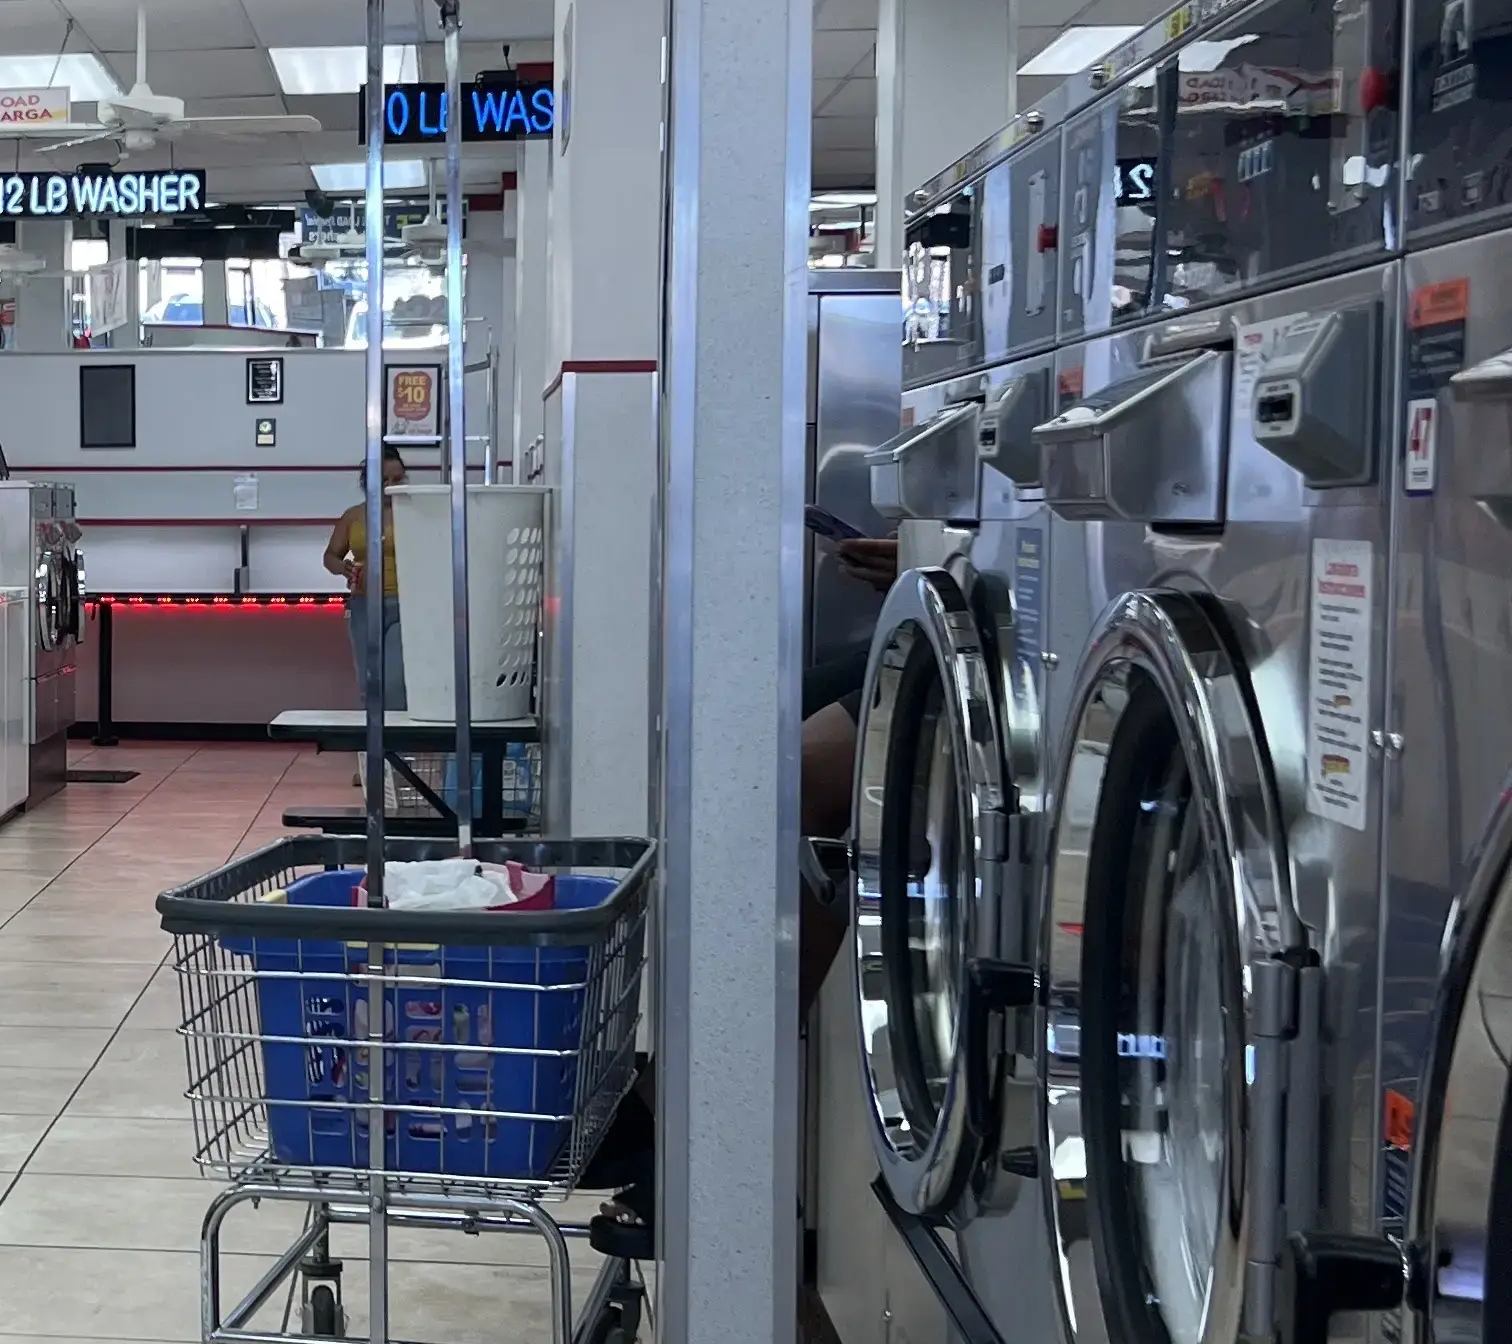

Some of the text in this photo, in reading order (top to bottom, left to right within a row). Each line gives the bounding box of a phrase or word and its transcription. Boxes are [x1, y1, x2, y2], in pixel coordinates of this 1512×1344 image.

[471, 87, 554, 135] WAS
[29, 175, 68, 215] LB
[71, 174, 201, 214] WASHER
[396, 386, 425, 404] $10
[398, 376, 426, 386] FREE
